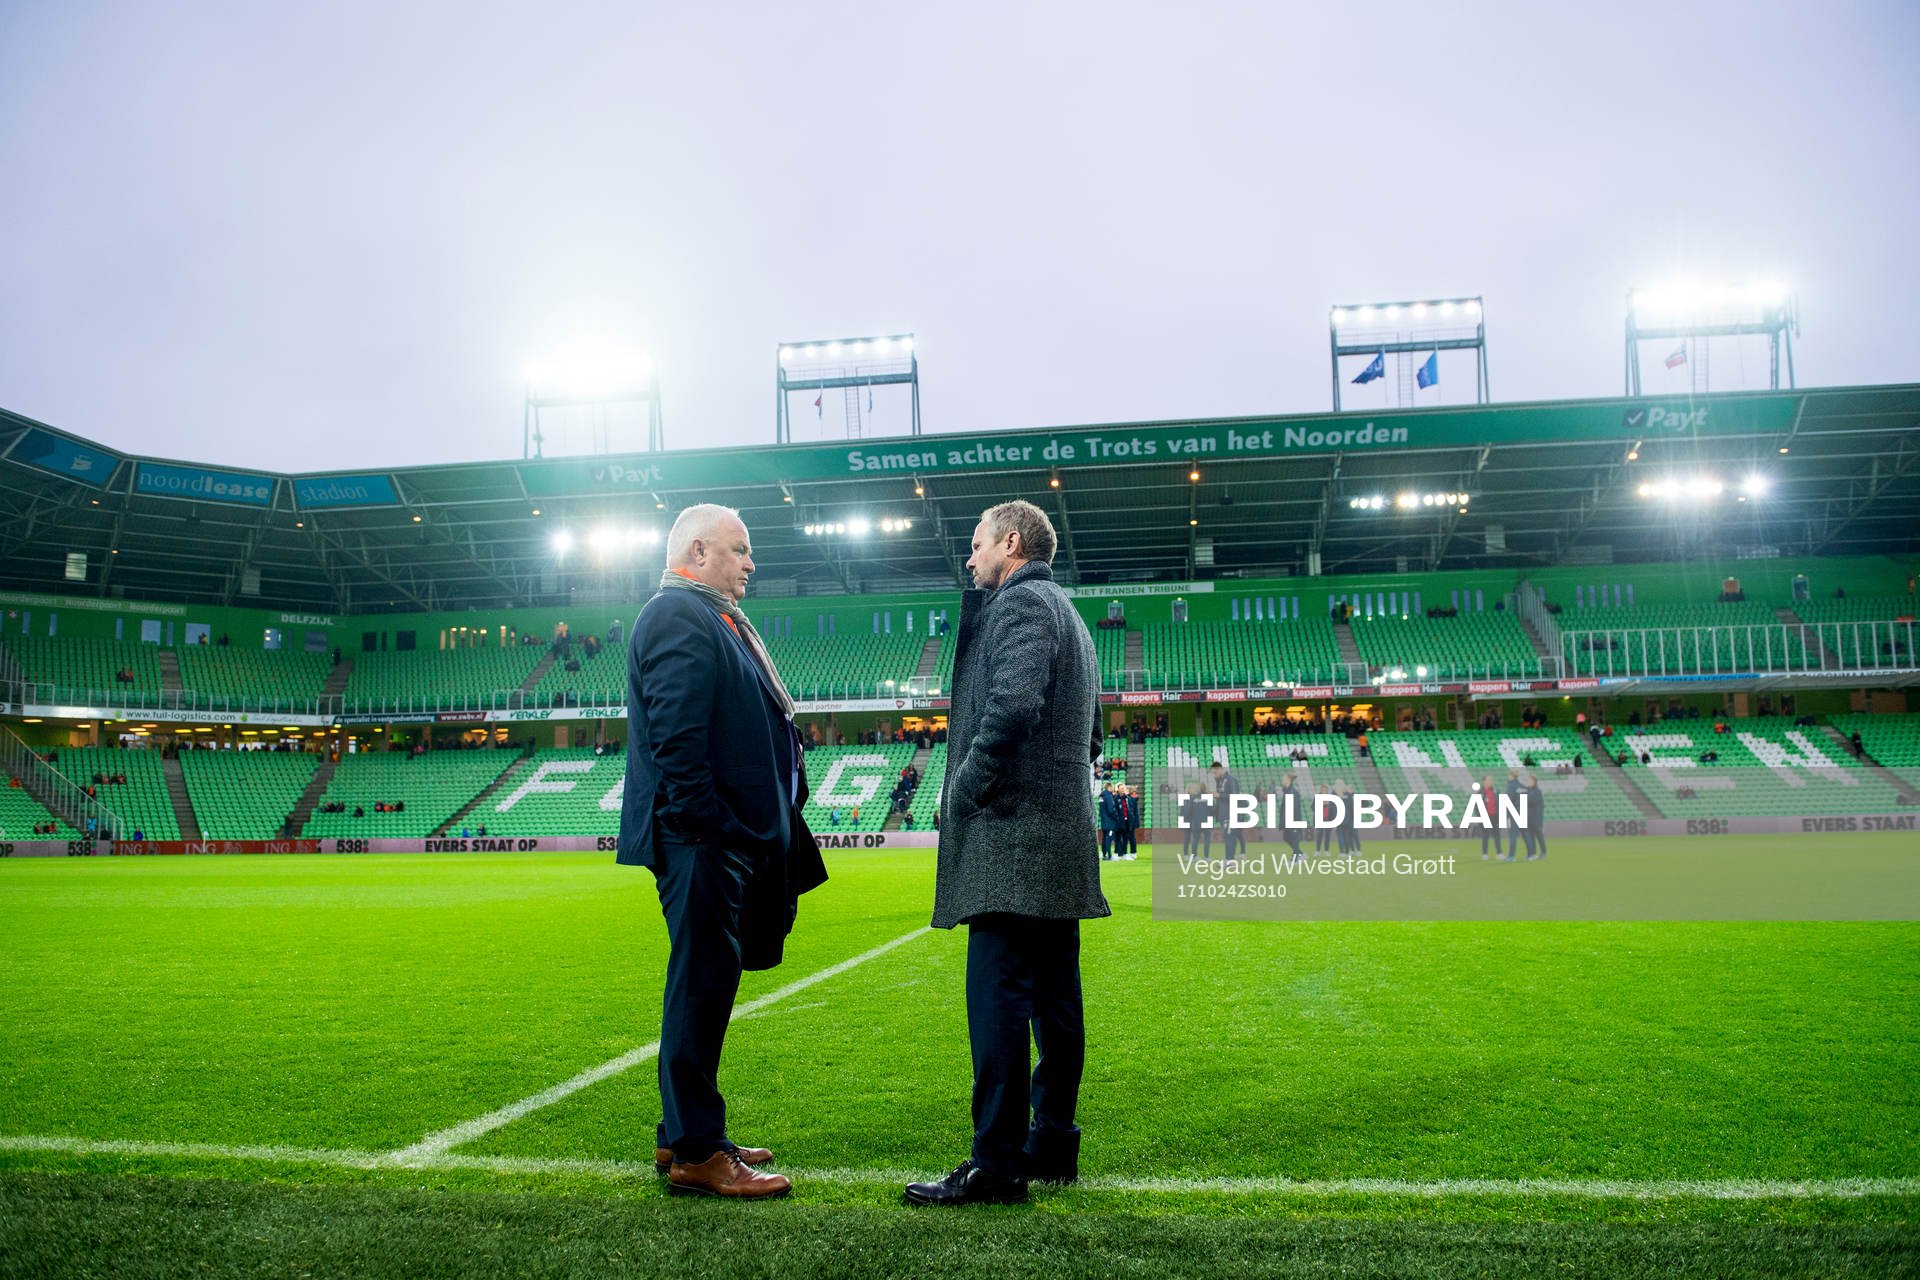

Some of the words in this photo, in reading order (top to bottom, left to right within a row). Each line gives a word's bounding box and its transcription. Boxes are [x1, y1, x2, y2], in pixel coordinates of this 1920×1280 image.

[1647, 407, 1708, 431] Payt
[848, 451, 937, 471] Samen
[948, 443, 1032, 465] achter
[1042, 440, 1075, 460] de
[1084, 438, 1157, 457] Trots
[1167, 436, 1216, 454] van
[1228, 430, 1273, 450] het
[1284, 423, 1408, 447] Noorden
[608, 464, 664, 486] Payt
[139, 472, 268, 499] noordlease
[302, 482, 367, 502] stadion
[1074, 588, 1095, 596] PIET
[1099, 586, 1146, 595] FRANSEN
[1149, 584, 1191, 593] TRIBUNE
[281, 613, 334, 626] DELFZIJL
[1122, 693, 1160, 703] kappers
[1207, 691, 1245, 701] kappers
[1292, 688, 1331, 698] kappers
[1380, 685, 1419, 695] kappers
[1470, 682, 1508, 692] kappers
[510, 710, 553, 720] VERKLEY
[579, 708, 622, 718] VERKLEY
[1604, 820, 1638, 836] 538
[1687, 818, 1721, 835] 538
[1802, 816, 1857, 832] EVERS
[1862, 815, 1916, 831] STAAT
[68, 841, 92, 856] 538
[121, 844, 142, 856] ING
[185, 843, 217, 856] ING
[265, 842, 290, 855] ING
[336, 839, 362, 853] 538
[425, 839, 468, 852] EVERS
[472, 838, 514, 852] STAAT
[518, 838, 538, 851] OP
[597, 836, 619, 851] 53
[815, 835, 859, 849] STAAT
[864, 834, 885, 848] OP
